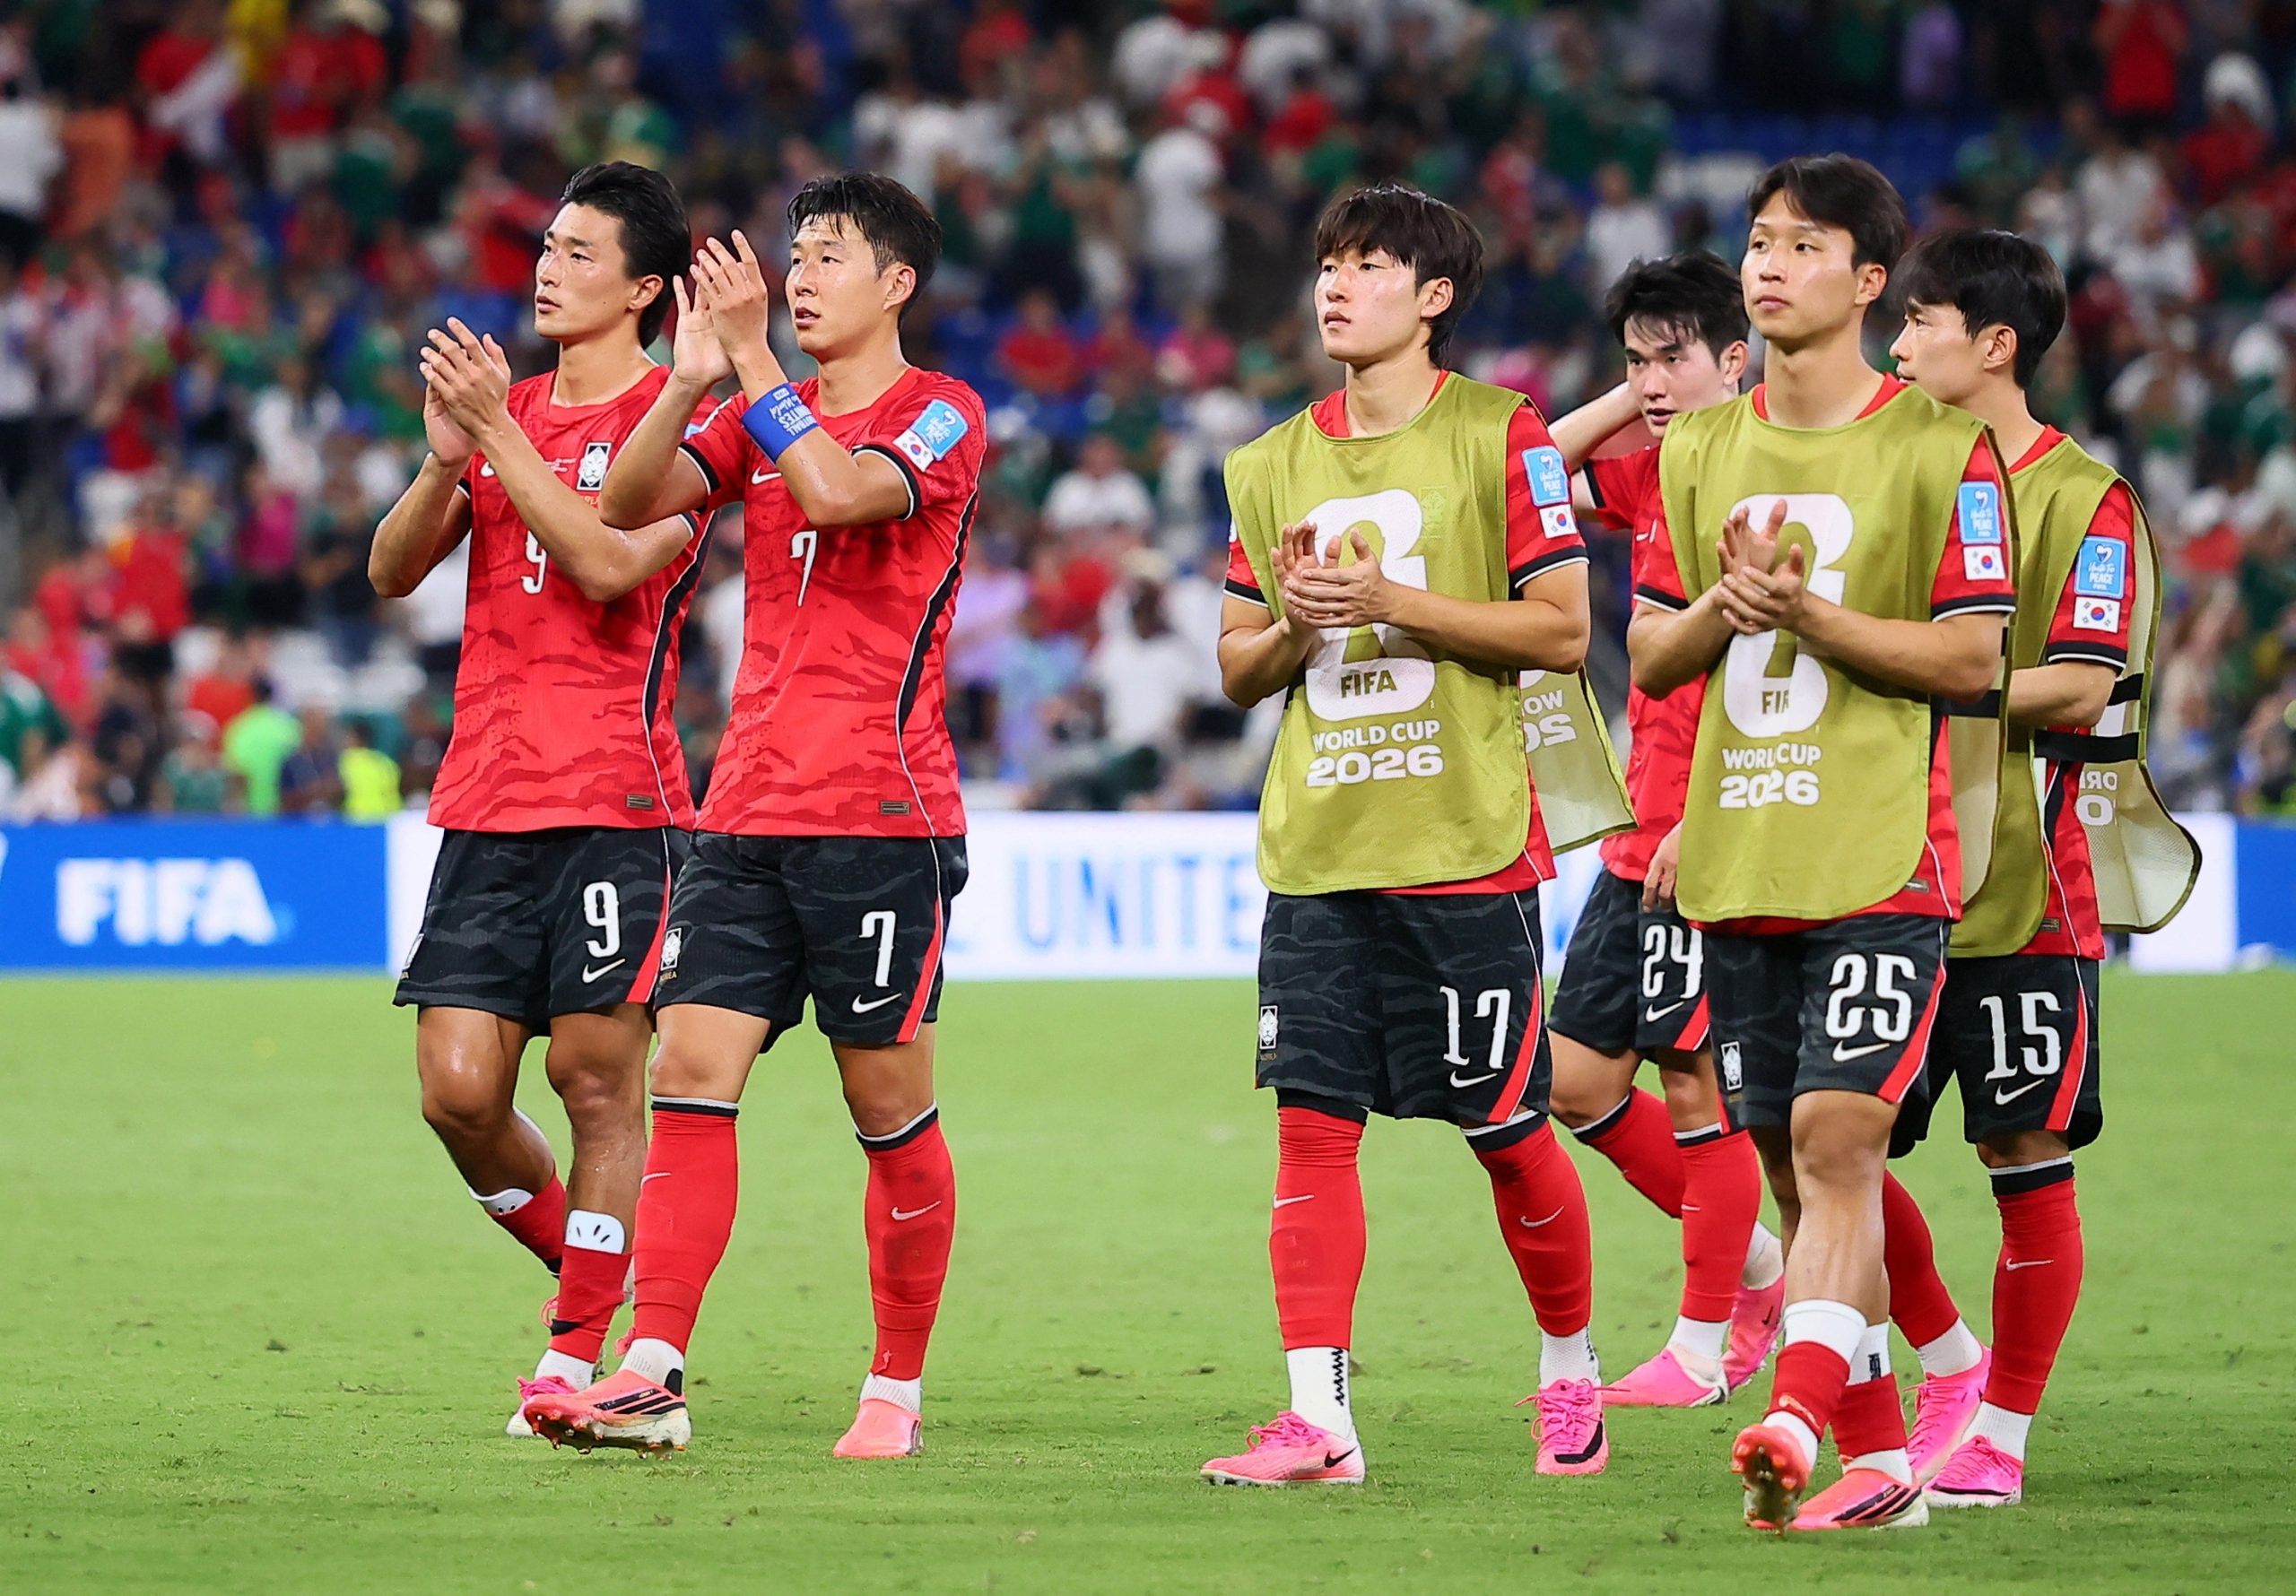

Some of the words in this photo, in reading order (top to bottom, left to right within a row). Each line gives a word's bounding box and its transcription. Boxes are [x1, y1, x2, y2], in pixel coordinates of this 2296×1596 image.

[520, 530, 547, 594] 9
[789, 530, 818, 608] 7
[2089, 572, 2113, 584] PEACE
[1340, 669, 1398, 698] FIFA
[1306, 744, 1444, 787] 2026
[1311, 725, 1387, 753] WORLD
[1391, 719, 1440, 742] CUP
[1776, 742, 1822, 766] CUP
[1718, 769, 1821, 809] 2026
[56, 856, 277, 947] FIFA
[583, 880, 621, 959] 9
[858, 910, 897, 988] 7
[1642, 924, 1703, 1000] 24
[1439, 984, 1510, 1071] 17
[1825, 954, 1916, 1044] 25
[1979, 990, 2063, 1083] 15
